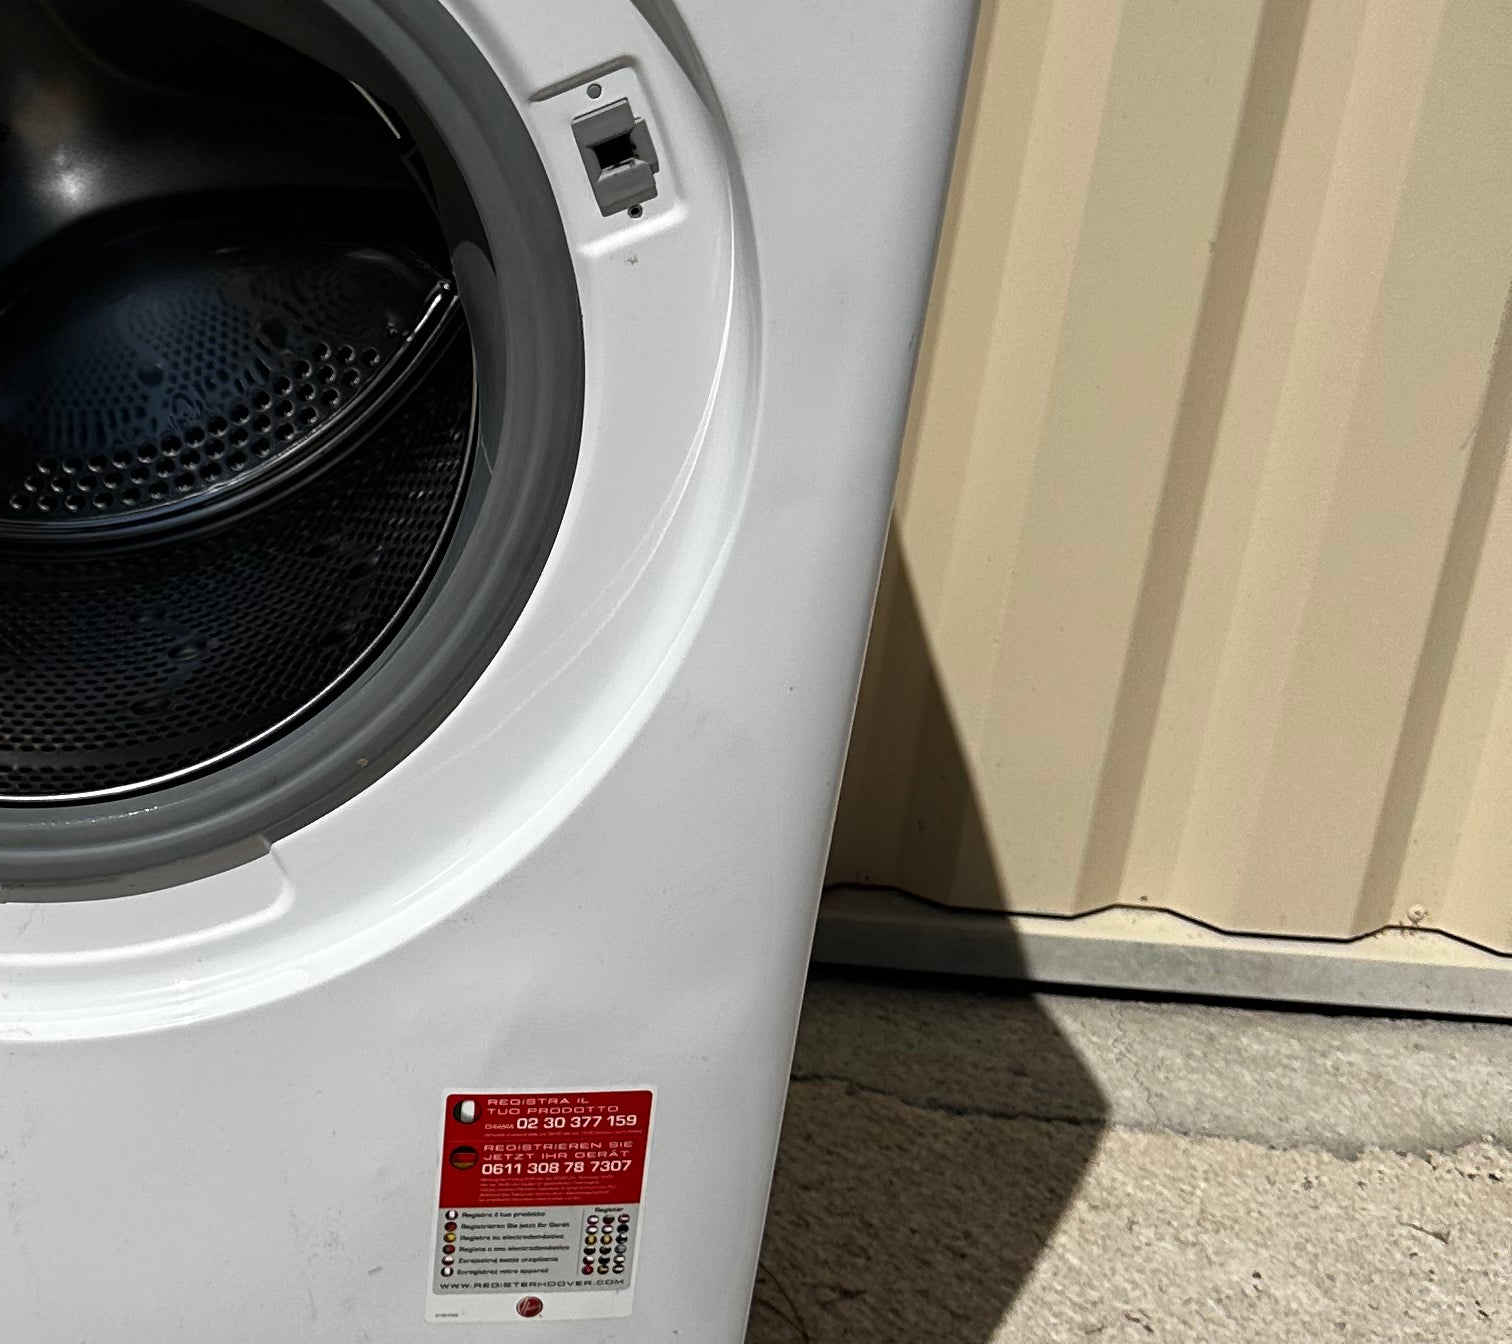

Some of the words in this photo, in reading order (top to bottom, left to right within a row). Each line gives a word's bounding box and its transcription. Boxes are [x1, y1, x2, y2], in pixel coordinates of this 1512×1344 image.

[488, 1098, 570, 1106] REGISTRA
[527, 1106, 619, 1114] PRODOTTO
[517, 1117, 538, 1129] 02
[543, 1117, 565, 1129] 30
[570, 1116, 602, 1128] 377
[607, 1114, 637, 1126] 159
[483, 1142, 602, 1152] REGISTRIEREN
[483, 1153, 535, 1161] JETZT
[575, 1150, 629, 1159] GERÄT
[482, 1163, 521, 1175] 0611
[527, 1162, 559, 1174] 308
[564, 1162, 584, 1173] 78
[590, 1160, 632, 1172] 7307
